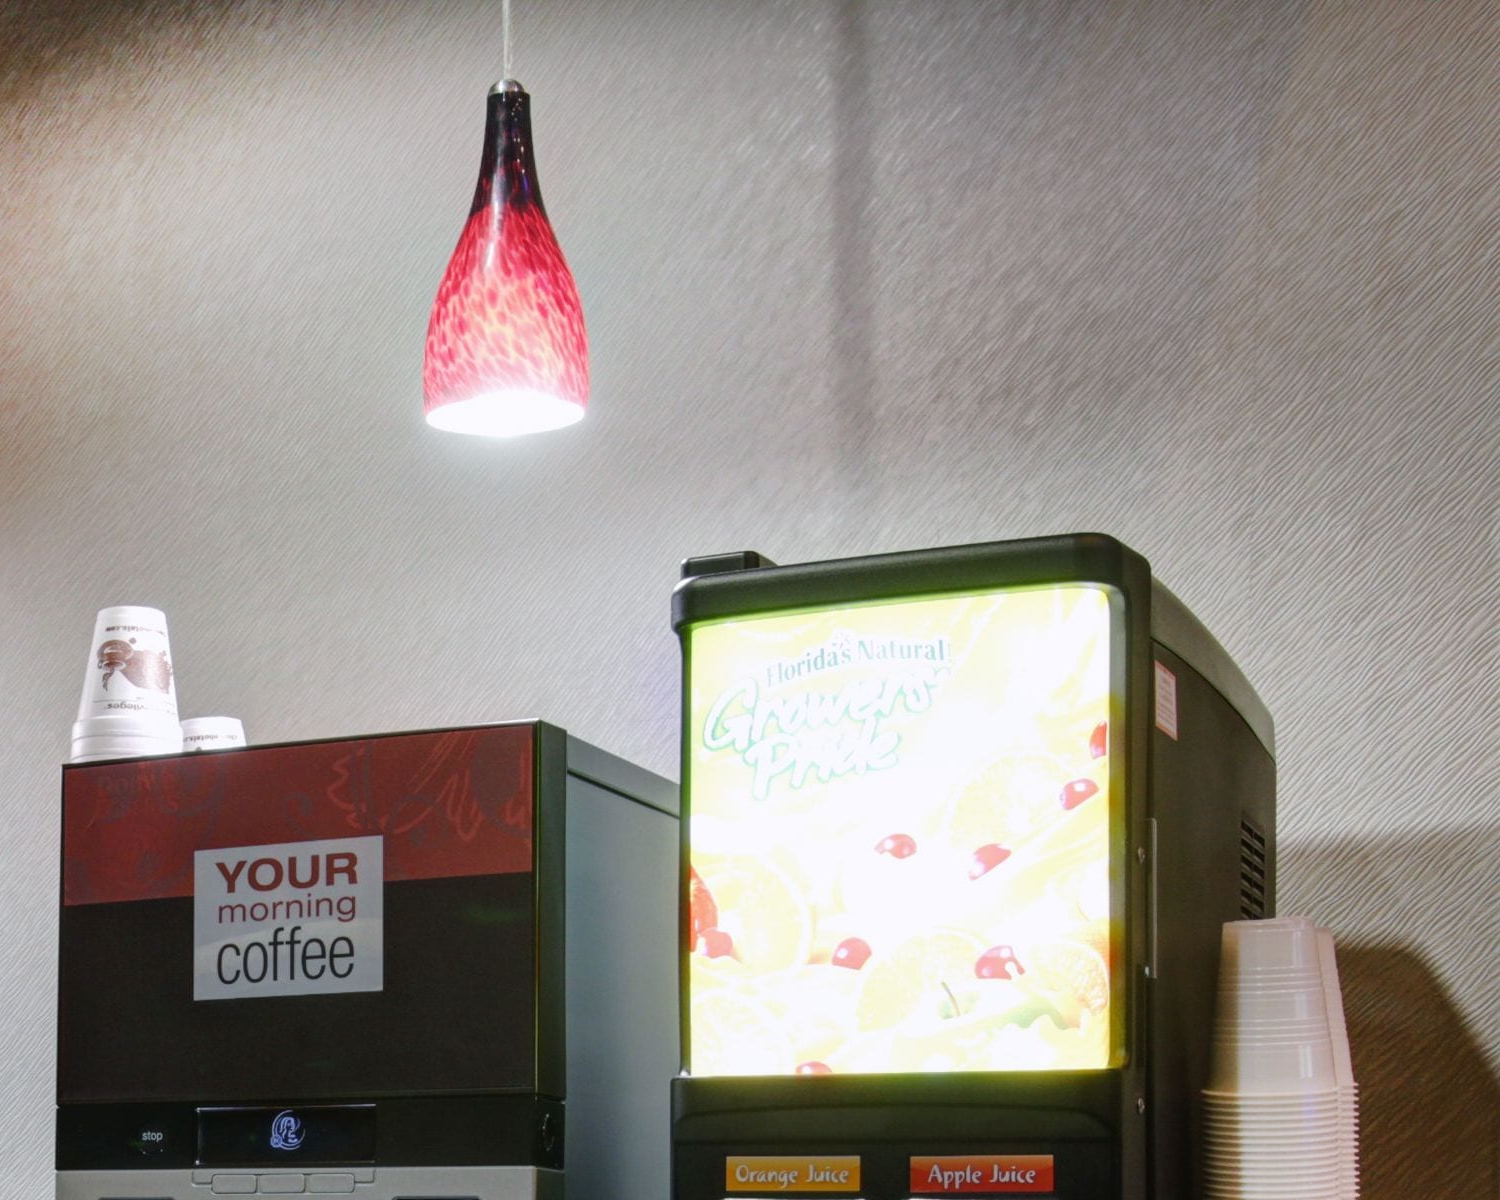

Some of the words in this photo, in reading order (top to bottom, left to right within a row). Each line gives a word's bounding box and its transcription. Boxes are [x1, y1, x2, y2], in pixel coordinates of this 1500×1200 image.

[857, 639, 941, 662] Natural
[215, 852, 358, 894] YOUR
[218, 893, 356, 924] morning
[217, 926, 355, 985] coffee
[142, 1131, 164, 1142] stop
[735, 1164, 799, 1189] Orange
[805, 1164, 850, 1184] Juice
[927, 1164, 983, 1190] Apple
[989, 1164, 1036, 1184] Juice
